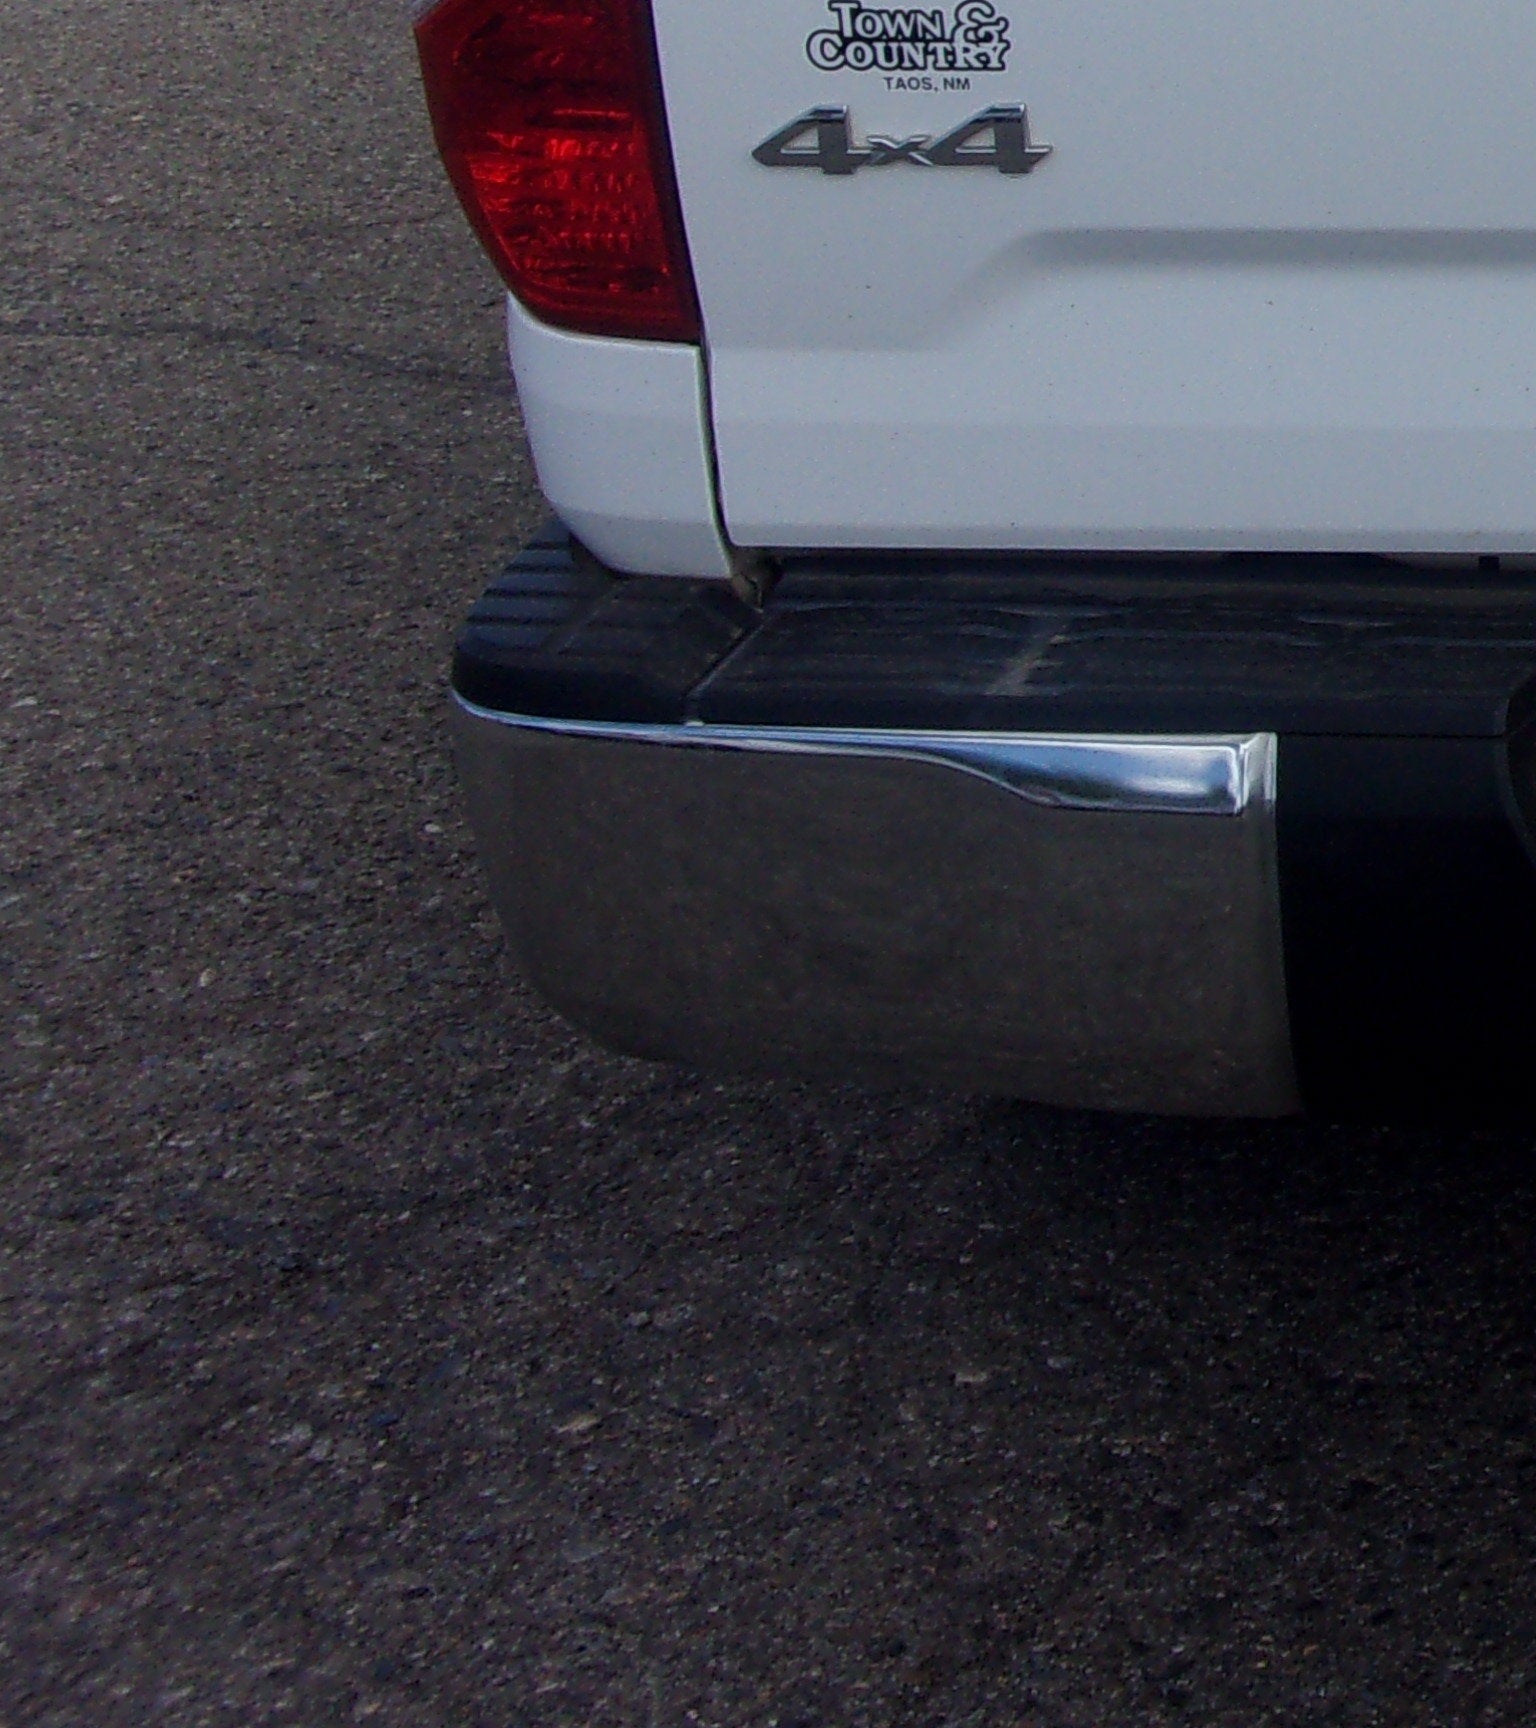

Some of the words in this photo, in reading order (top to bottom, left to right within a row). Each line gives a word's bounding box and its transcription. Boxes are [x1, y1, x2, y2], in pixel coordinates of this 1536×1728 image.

[883, 76, 939, 93] TAOS,
[943, 76, 971, 92] NM
[751, 102, 1054, 175] 4x4
